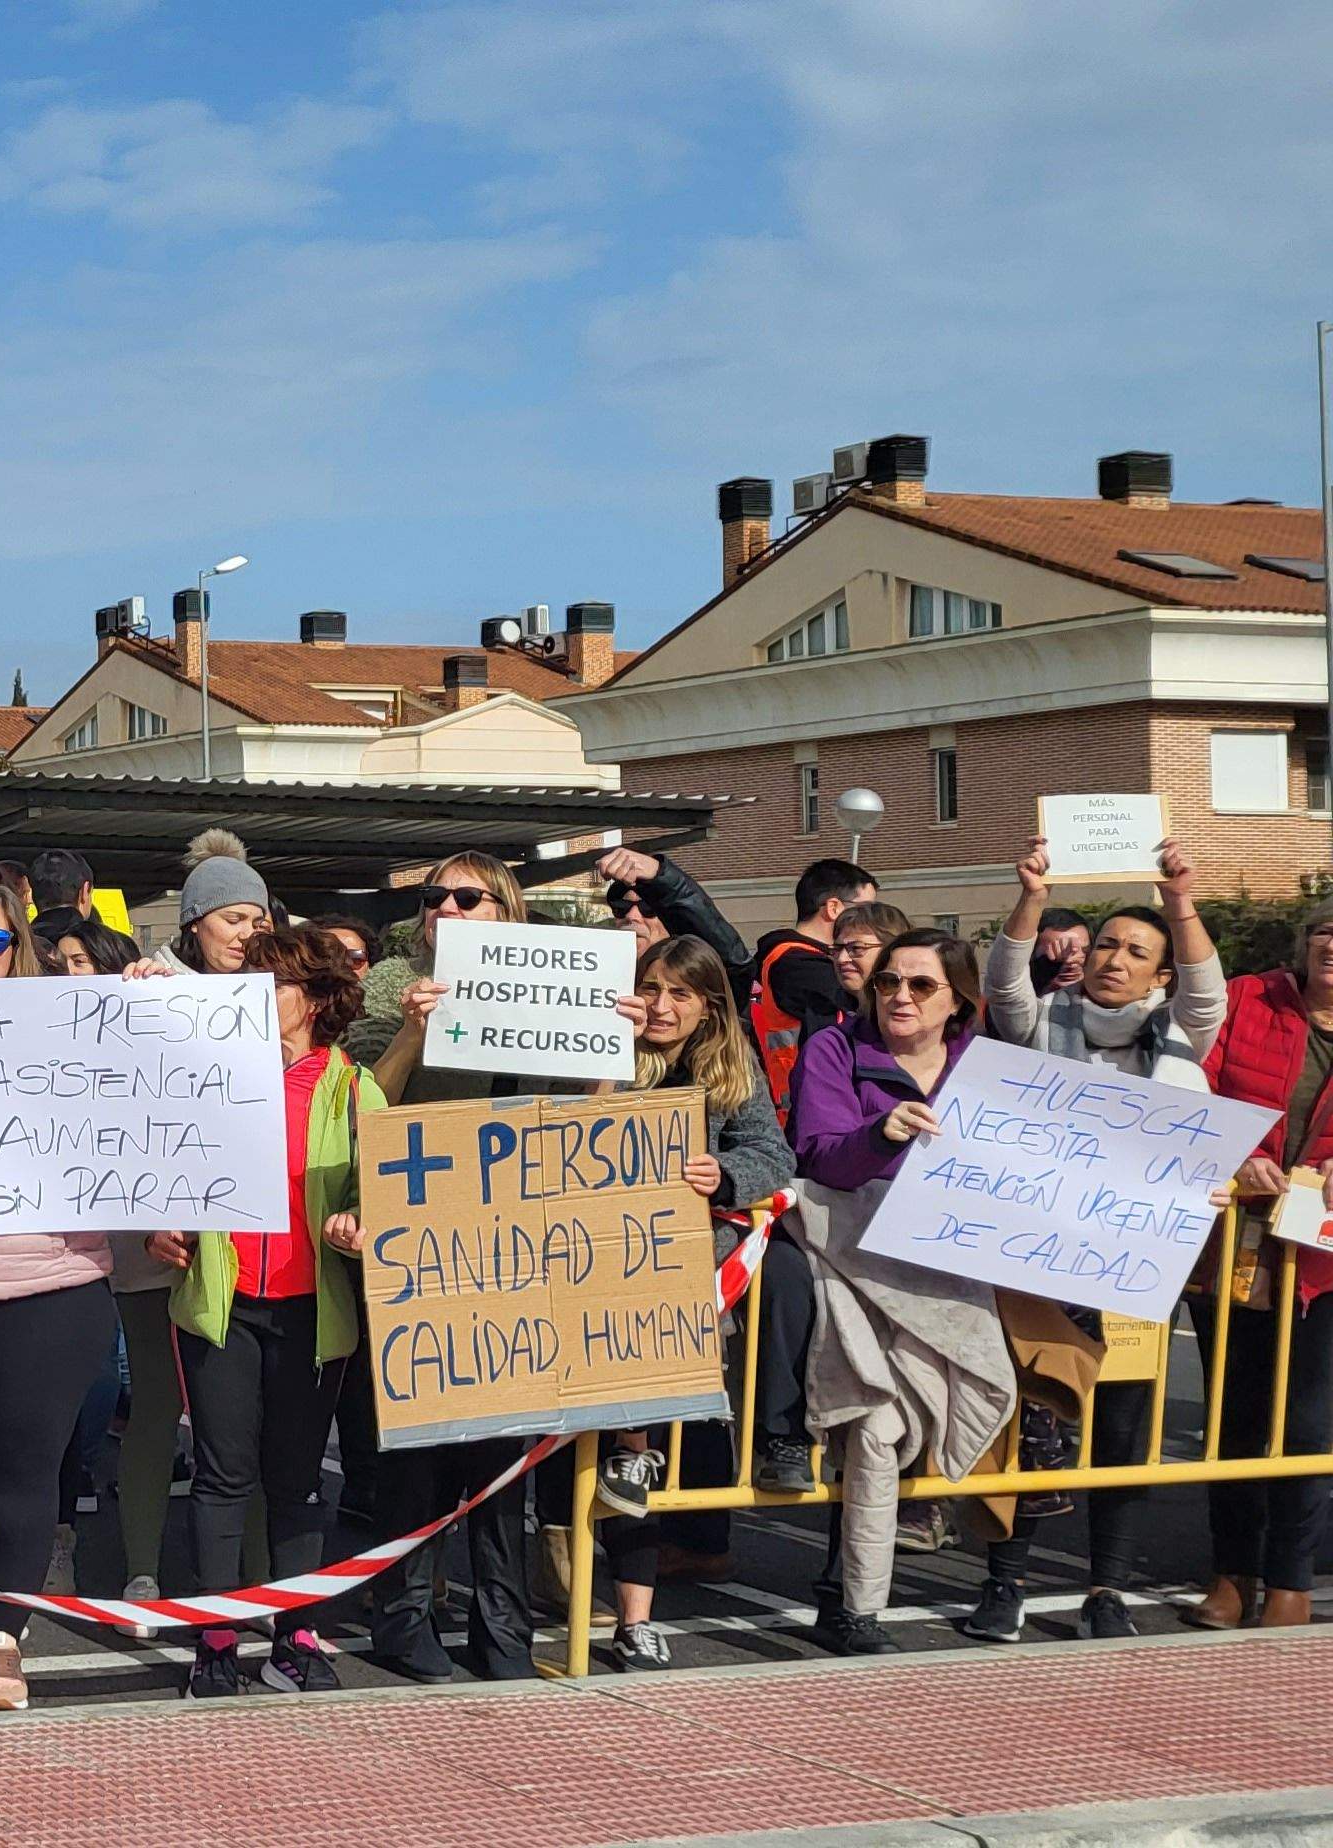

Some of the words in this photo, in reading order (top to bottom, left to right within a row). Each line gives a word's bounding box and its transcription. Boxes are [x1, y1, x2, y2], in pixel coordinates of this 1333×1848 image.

[1073, 812, 1133, 823] PERSONAL
[1089, 828, 1119, 836] PARA
[1072, 841, 1138, 852] URGENCIAS
[481, 945, 598, 971] MEJORES
[456, 979, 617, 1009] HOSPITALES
[481, 1027, 620, 1055] RECURSOS
[1001, 1062, 1221, 1140] HUESCA
[1145, 1156, 1219, 1192] UNA
[63, 1168, 263, 1220] PARAR
[912, 1213, 997, 1248] DE
[1078, 1183, 1211, 1247] URGENTE
[623, 1209, 683, 1279] DE
[584, 1302, 717, 1366] HUMANA
